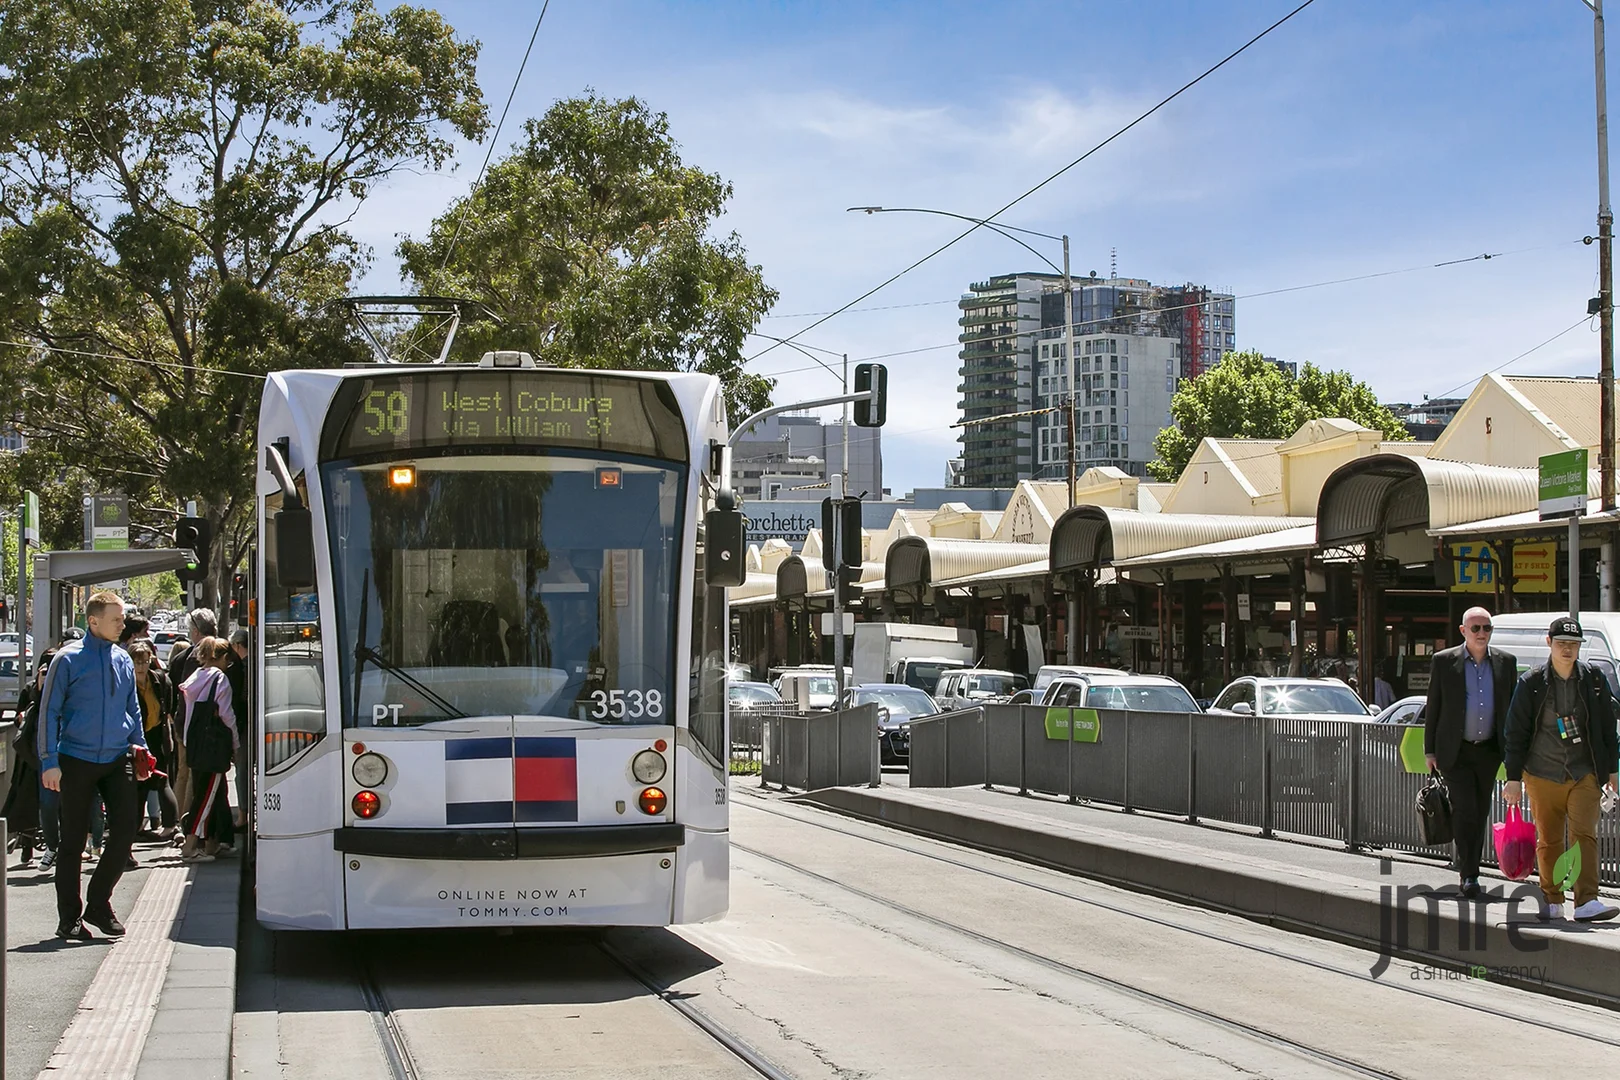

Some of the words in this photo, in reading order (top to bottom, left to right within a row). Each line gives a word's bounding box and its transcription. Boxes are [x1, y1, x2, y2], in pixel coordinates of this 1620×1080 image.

[442, 391, 502, 412] West
[517, 391, 613, 413] Coburg
[364, 390, 408, 436] 58
[442, 416, 480, 437] via
[495, 416, 571, 437] William
[586, 416, 613, 437] St
[1458, 546, 1493, 584] EA
[590, 689, 663, 719] 3538
[372, 704, 404, 726] PT
[263, 793, 281, 811] 3538
[715, 788, 726, 805] 3538
[437, 890, 506, 900] ONLINE
[517, 889, 559, 900] NOW
[567, 888, 587, 899] AT
[458, 906, 569, 917] TOMMY.COM
